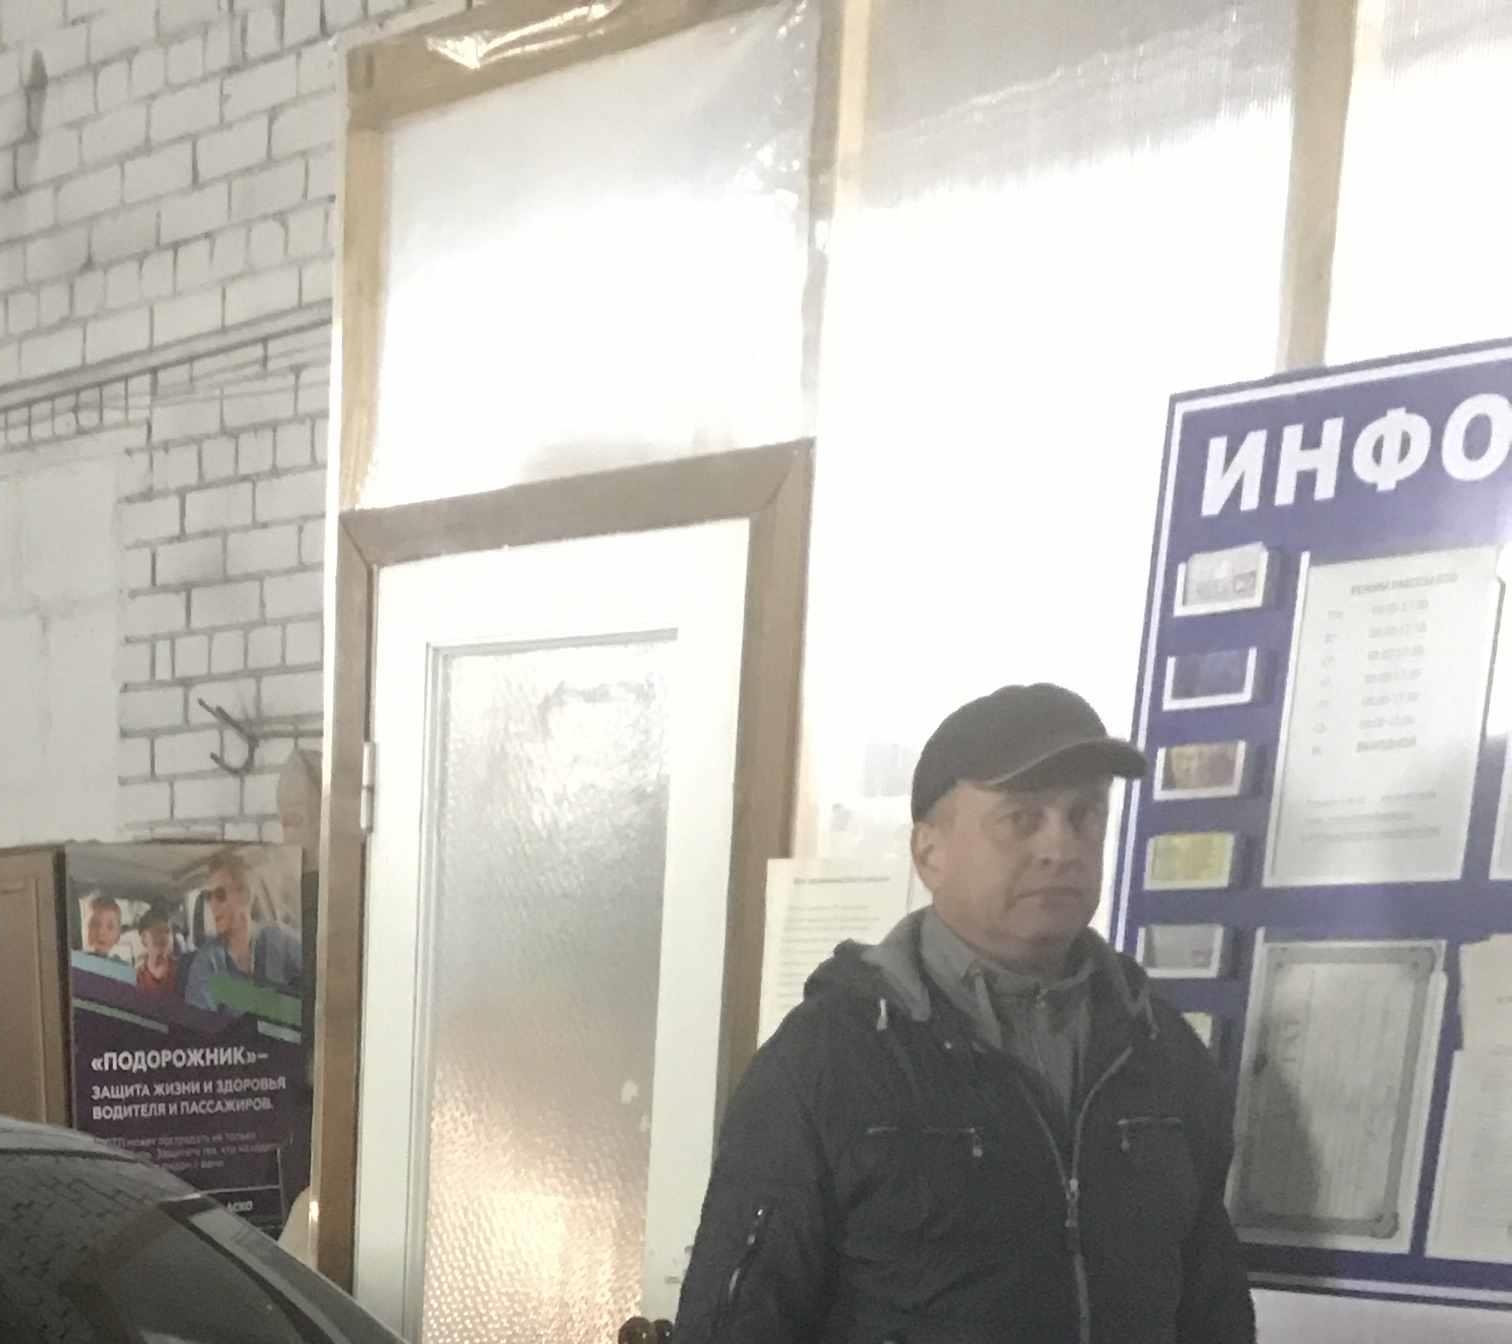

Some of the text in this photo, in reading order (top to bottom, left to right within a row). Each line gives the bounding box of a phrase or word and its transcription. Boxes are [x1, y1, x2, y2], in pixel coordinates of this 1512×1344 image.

[1201, 393, 1512, 518] ИНФО
[92, 1075, 287, 1101] ЗАЩИТА ЖИЗНИ И ЗДОРОВЬЯ
[92, 1101, 167, 1121] ВОДИТЕЛЯ
[168, 1101, 178, 1116] И
